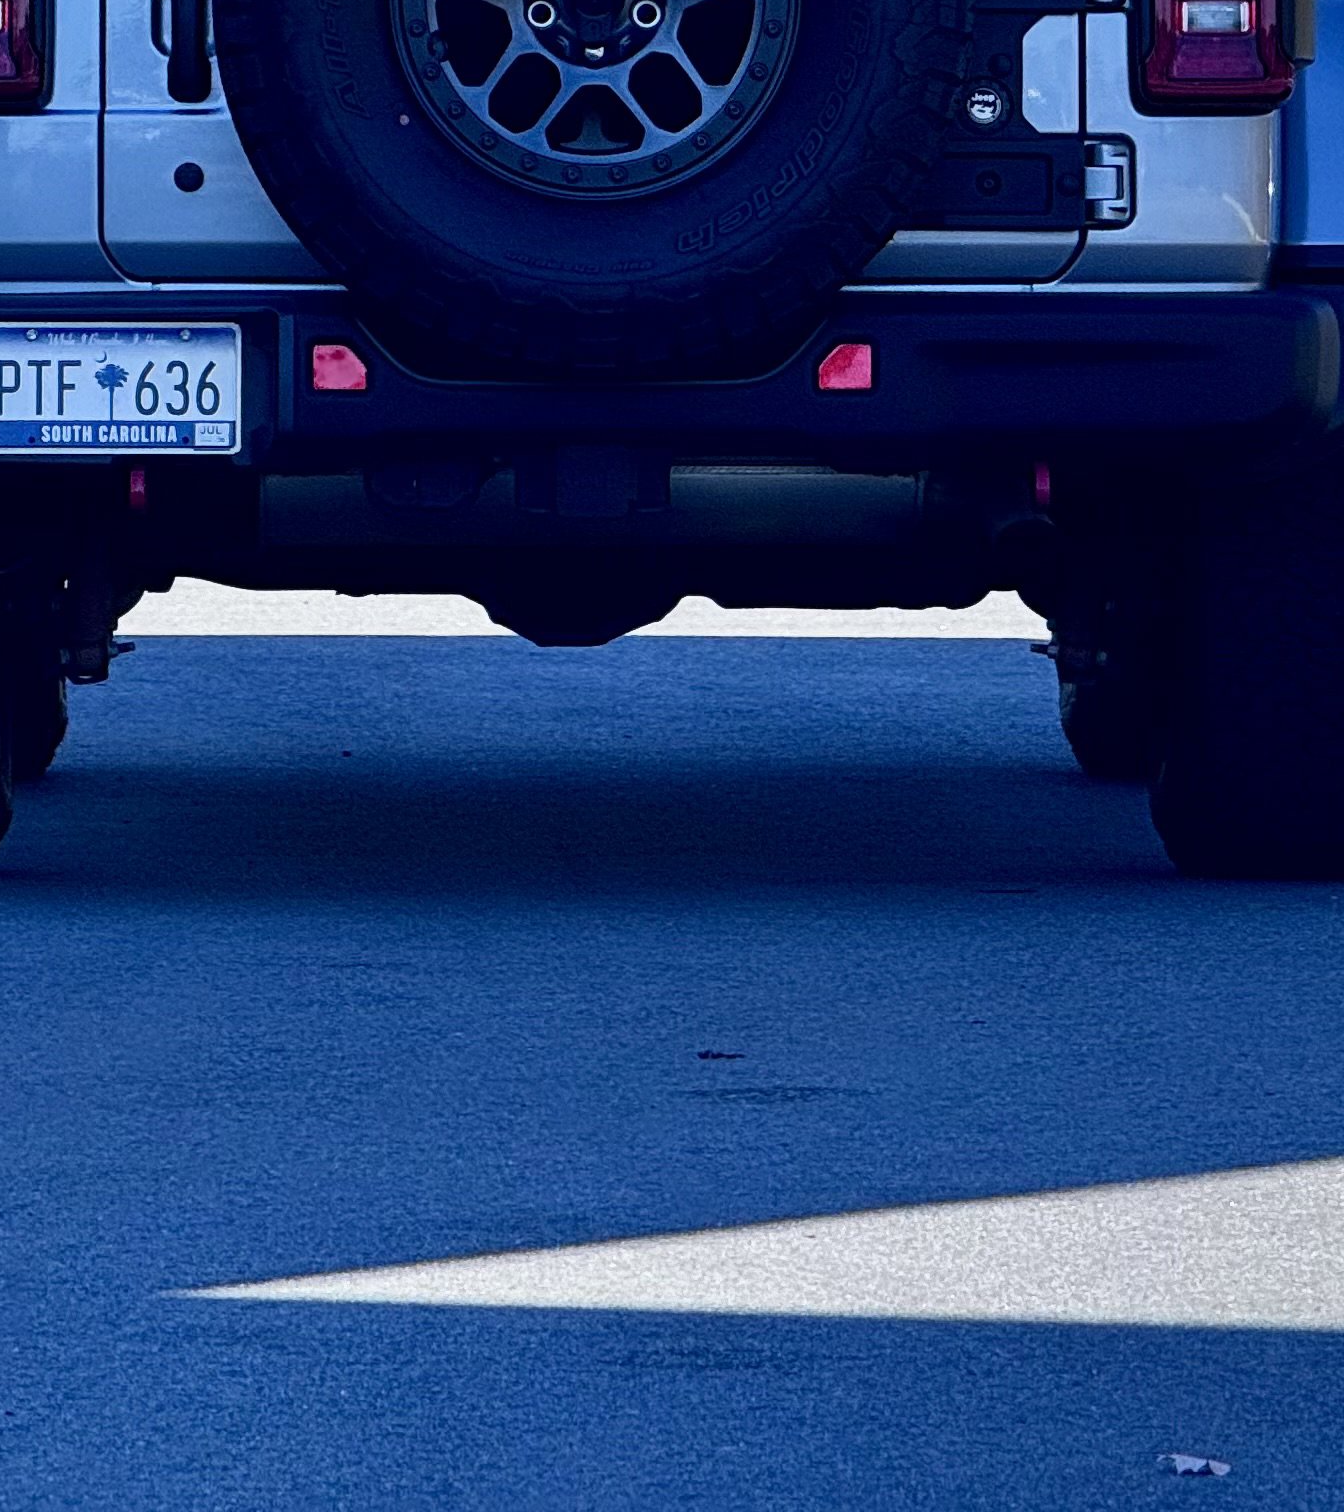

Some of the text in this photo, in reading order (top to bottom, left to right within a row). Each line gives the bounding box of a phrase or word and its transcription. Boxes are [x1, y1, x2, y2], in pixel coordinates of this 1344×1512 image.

[971, 92, 996, 103] Jeep
[135, 360, 221, 416] 636
[41, 424, 178, 443] SOUTH CAROLINA
[200, 425, 223, 435] JUL
